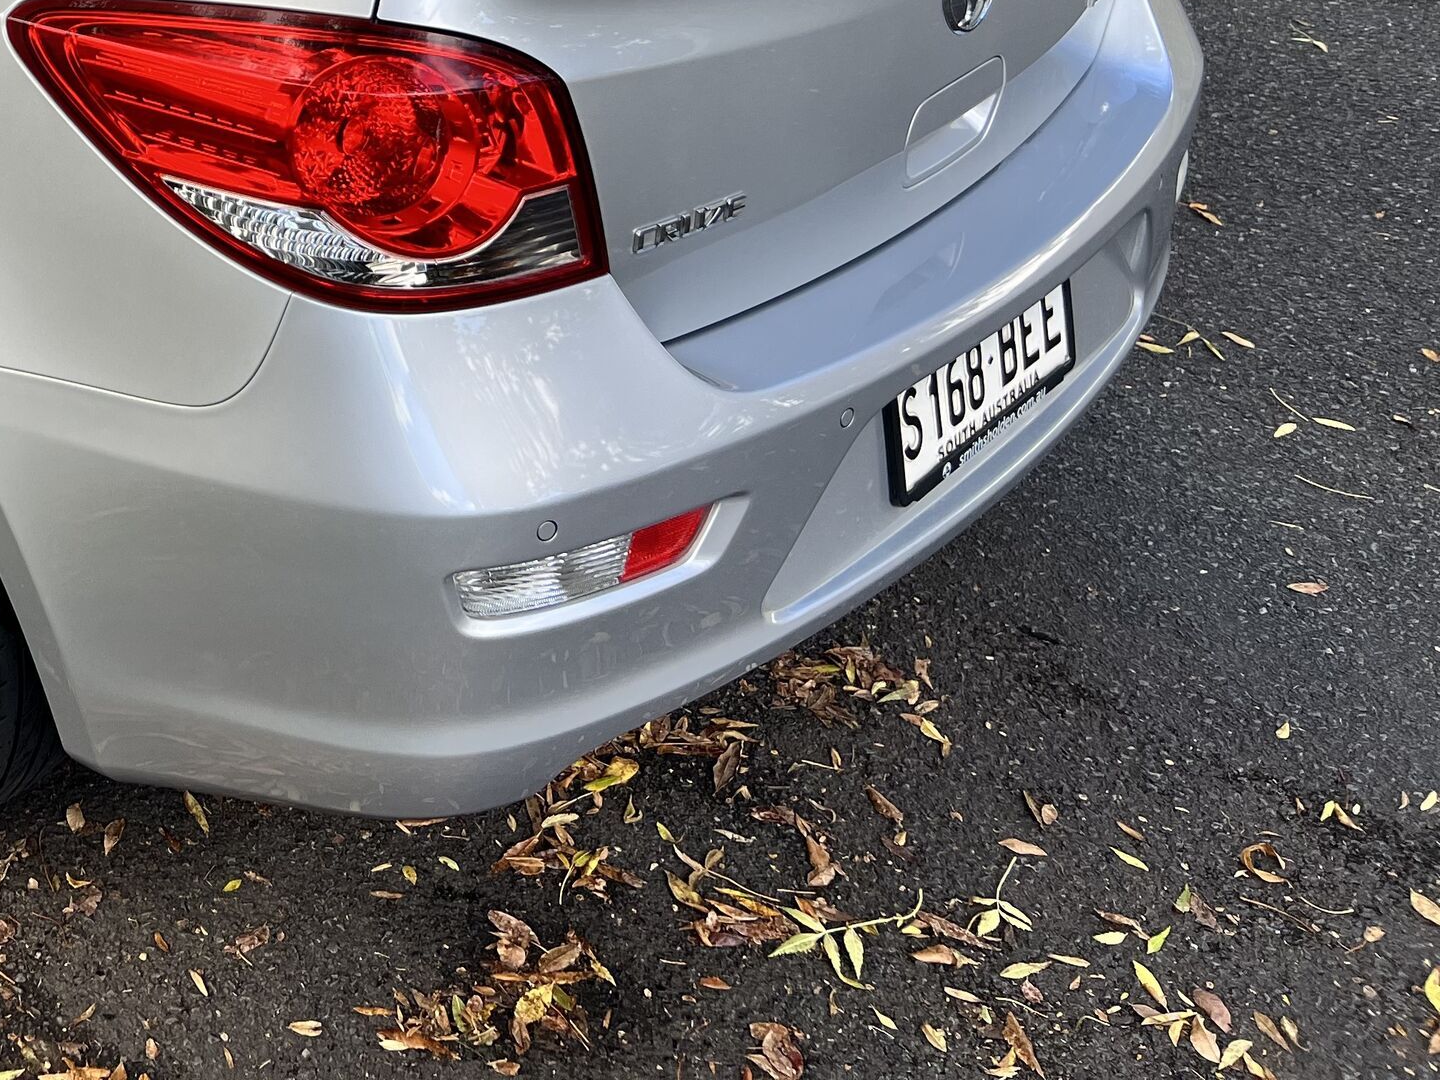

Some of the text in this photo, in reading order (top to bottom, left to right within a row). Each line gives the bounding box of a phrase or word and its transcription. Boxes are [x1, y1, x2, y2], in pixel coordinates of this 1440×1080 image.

[937, 370, 1041, 461] SOUTH AUSTRALIA
[958, 387, 1047, 467] smithsholden.com.au
